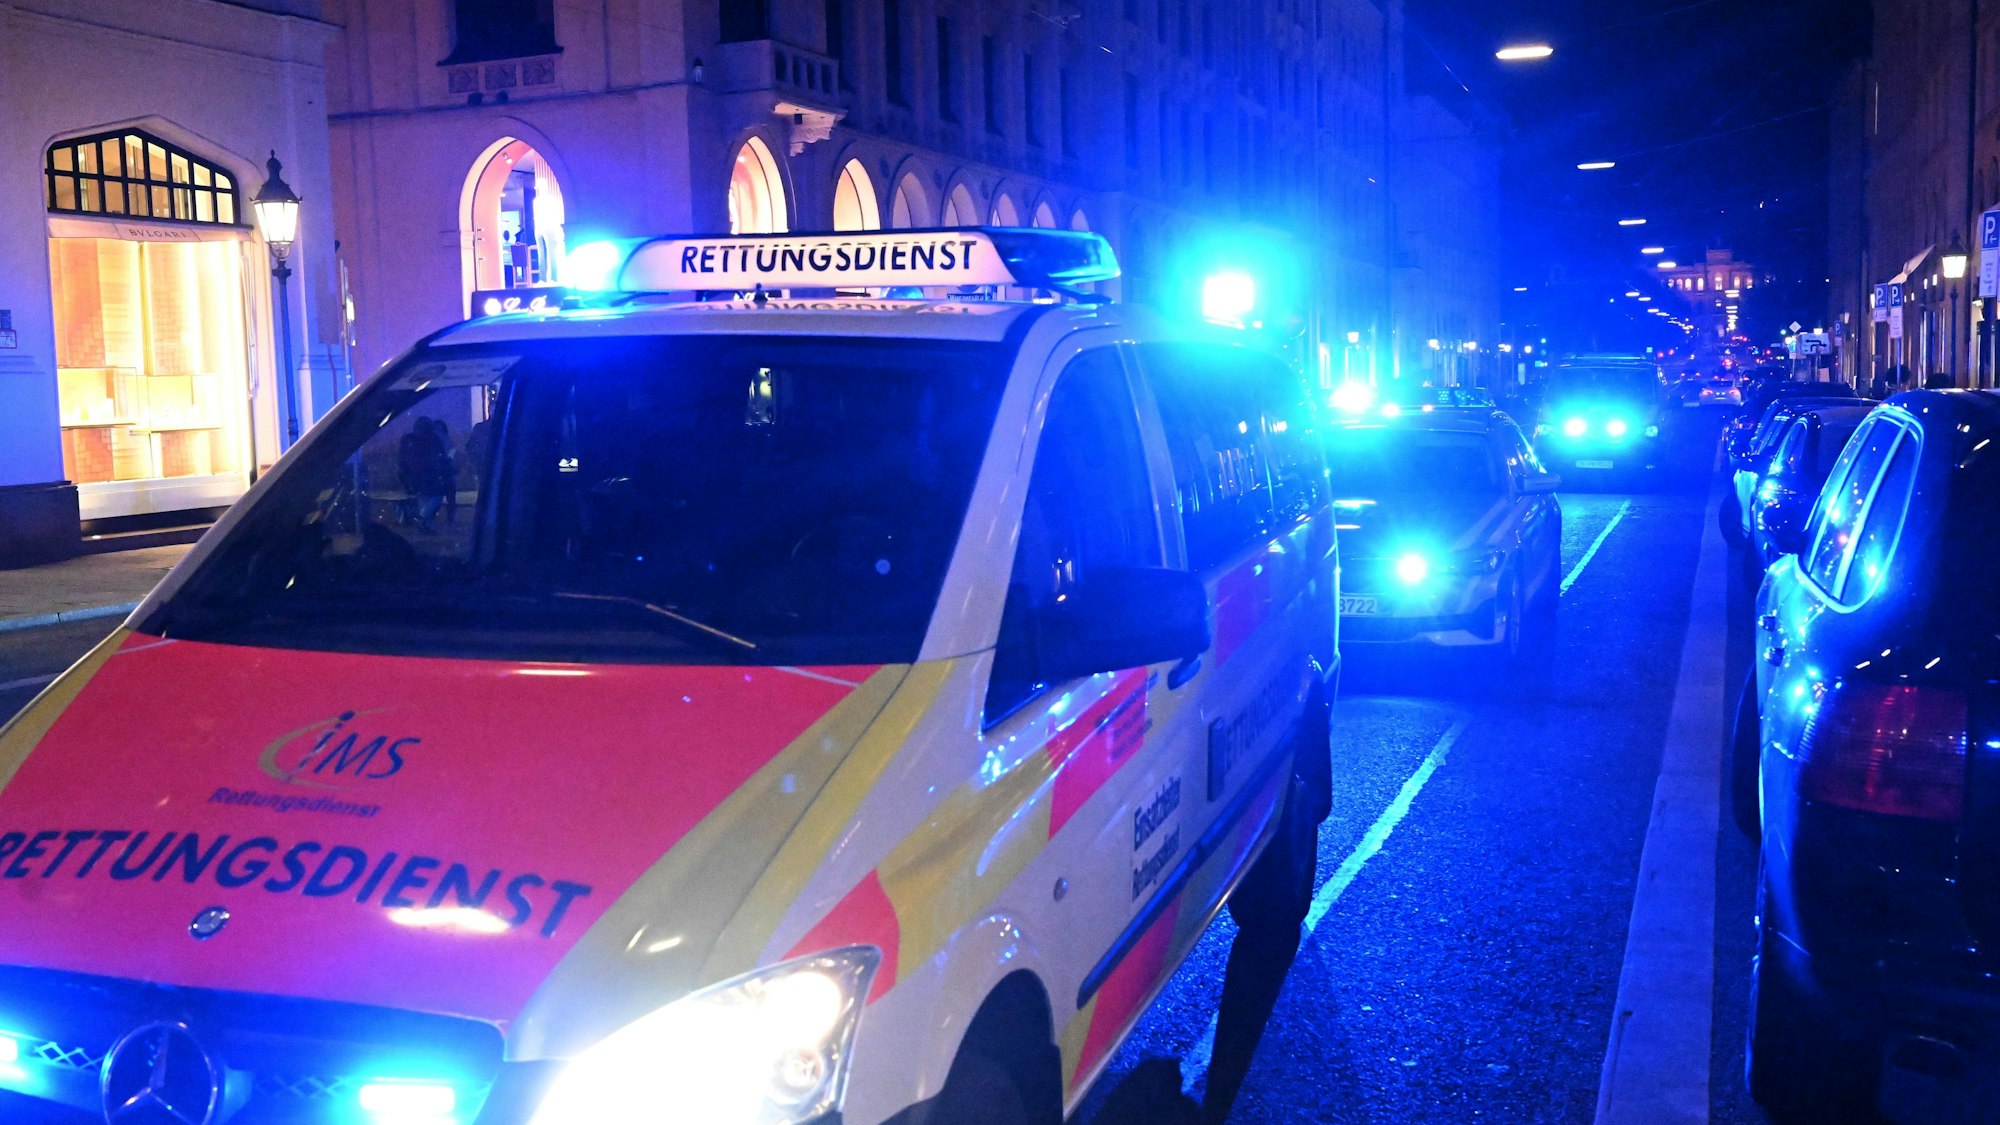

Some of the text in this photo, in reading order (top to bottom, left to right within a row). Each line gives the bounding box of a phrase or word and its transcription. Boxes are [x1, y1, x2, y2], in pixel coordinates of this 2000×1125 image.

[129, 228, 187, 238] BVLGARI
[1984, 216, 1996, 245] P
[680, 240, 977, 274] RETTUNGSDIENST
[949, 293, 992, 302] Wurzerstrae
[208, 786, 381, 819] Rettungsdienst
